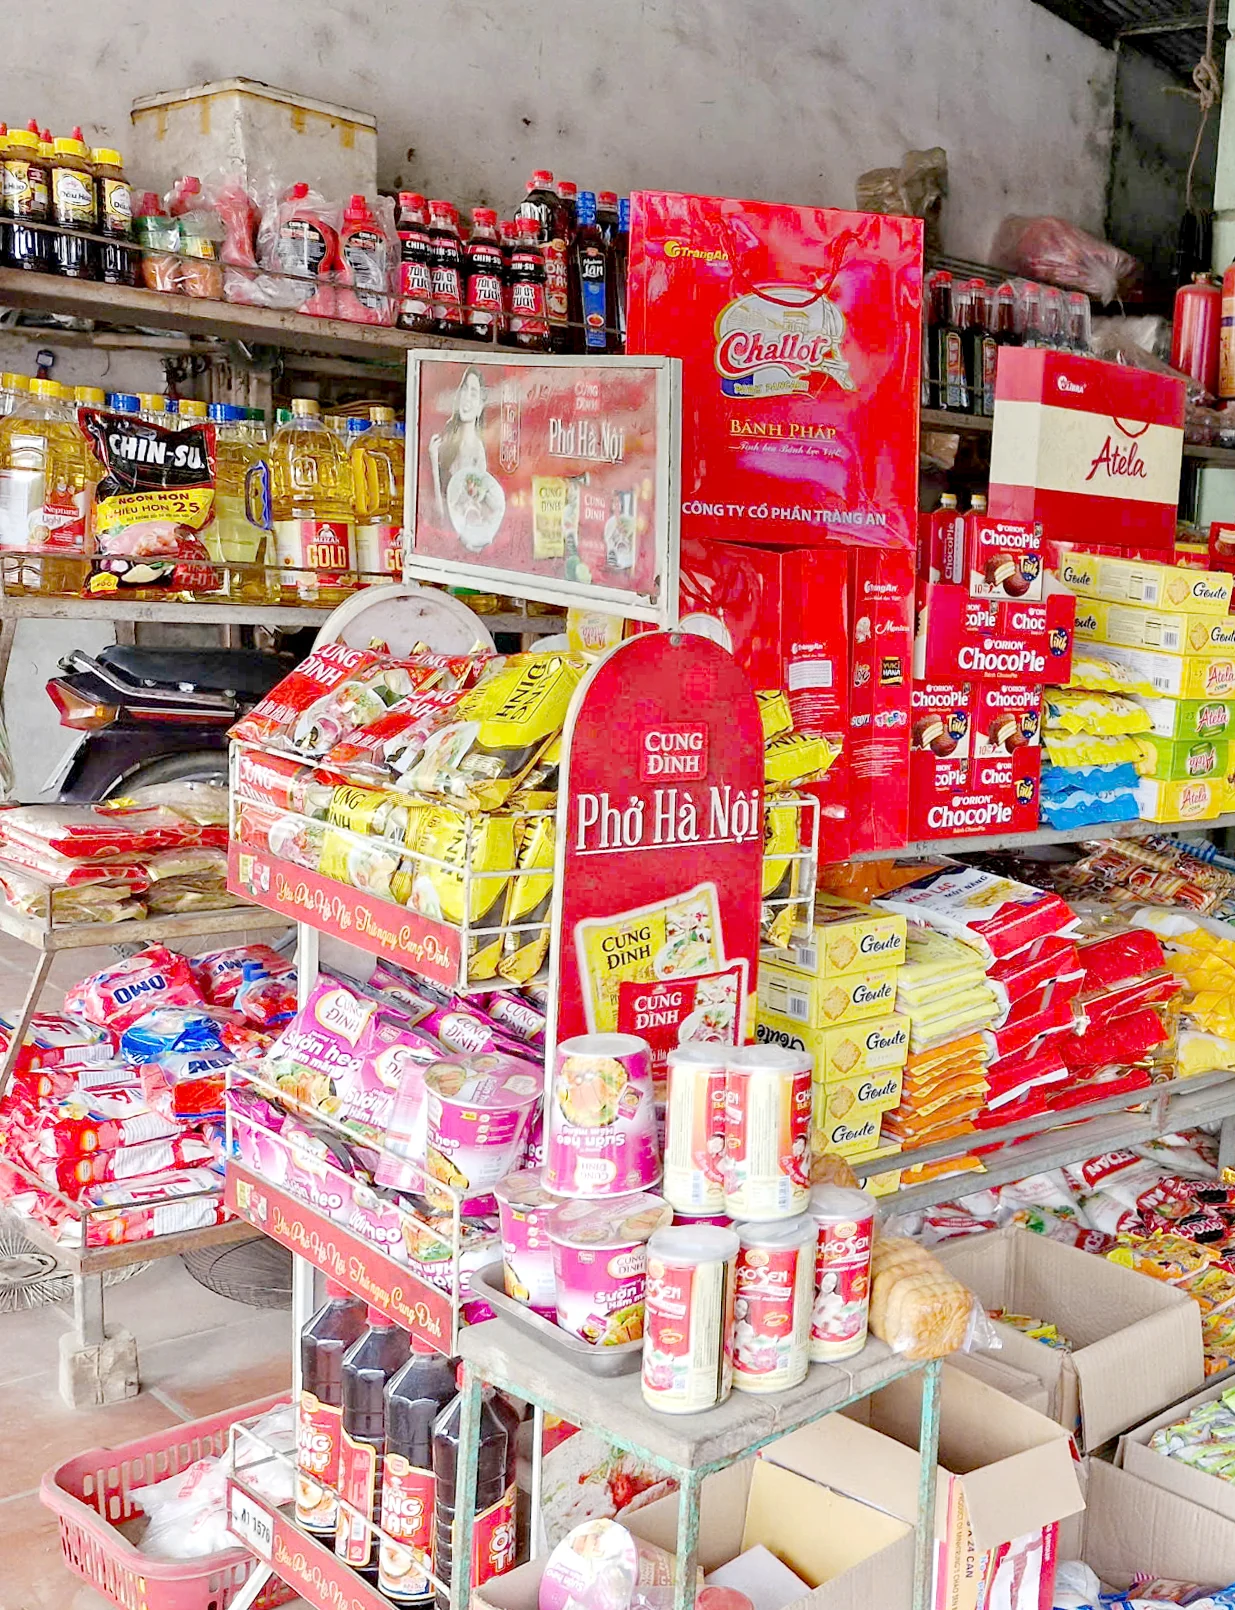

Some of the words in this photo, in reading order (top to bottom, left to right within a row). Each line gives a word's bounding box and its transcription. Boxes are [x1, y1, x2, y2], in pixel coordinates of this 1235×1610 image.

[717, 329, 828, 375] Challot
[730, 419, 781, 437] BÁNH
[789, 424, 836, 440] PHÁP
[109, 434, 201, 470] CHIN-SU
[1085, 436, 1148, 481] Atela
[173, 501, 200, 513] 25
[681, 501, 724, 516] CÔNG
[726, 504, 745, 516] TY
[866, 512, 886, 526] AN
[980, 529, 1040, 549] ChocoPie
[306, 544, 346, 568] GOLD
[994, 641, 1024, 650] ORION
[294, 655, 345, 686] ĐÌNH
[958, 647, 1045, 672] ChocoPie
[1206, 663, 1235, 688] Atela
[911, 691, 968, 707] ChocoPie
[986, 691, 1040, 707] ChocoPie
[1196, 703, 1230, 731] Atela
[645, 732, 703, 752] CUNG
[647, 753, 700, 774] ĐÌNH
[961, 795, 992, 804] ORION
[576, 793, 645, 849] Phở
[653, 789, 700, 843] Hà
[709, 786, 759, 843] Nội
[928, 802, 1012, 829] ChocoPie
[601, 926, 652, 953] CUNG
[607, 945, 651, 970] ĐÌNH
[113, 974, 166, 1005] OMO
[633, 991, 683, 1012] CUNG
[334, 993, 363, 1018] CUNG
[505, 1000, 540, 1027] CUNG
[635, 1009, 680, 1030] ĐÌNH
[965, 1556, 975, 1579] CAN
